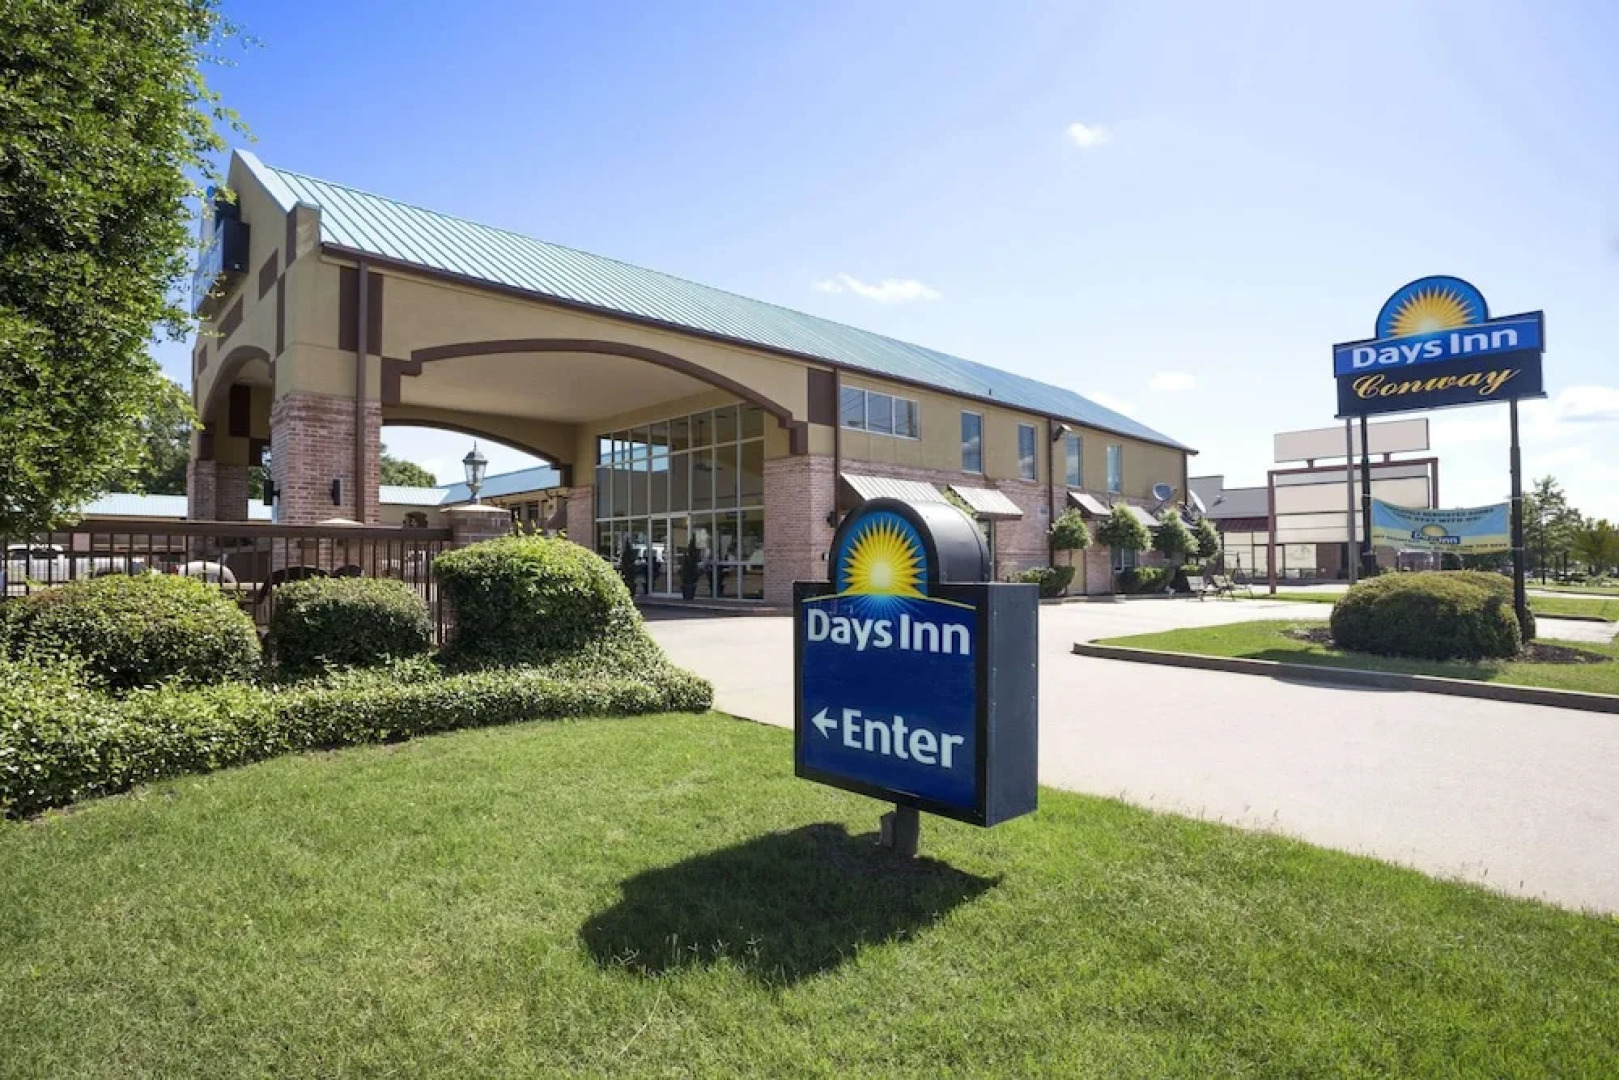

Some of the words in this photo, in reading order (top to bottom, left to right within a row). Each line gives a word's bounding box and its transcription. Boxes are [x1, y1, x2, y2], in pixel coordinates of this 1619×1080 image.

[1352, 338, 1442, 368] Days
[1450, 328, 1518, 354] Inn
[1352, 368, 1521, 399] Conway
[807, 608, 893, 651] Days
[900, 614, 971, 655] Inn
[842, 707, 965, 768] Enter
